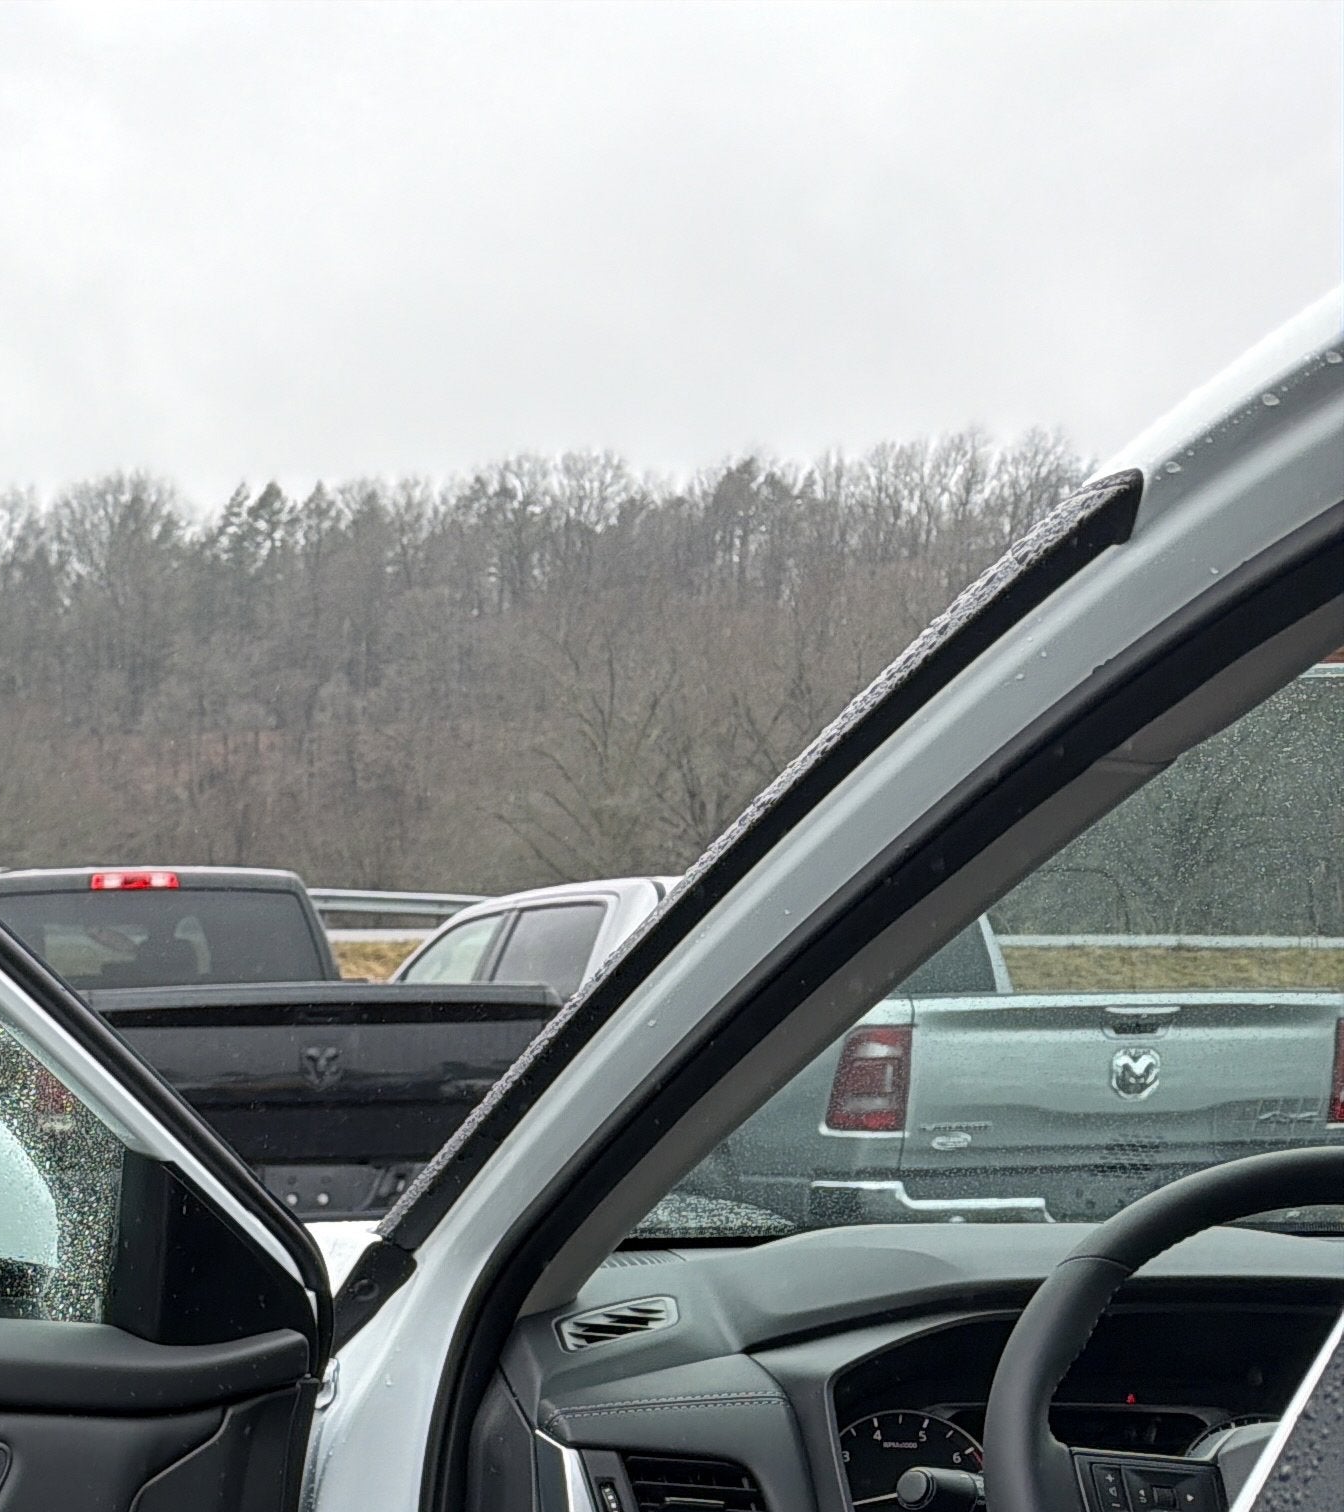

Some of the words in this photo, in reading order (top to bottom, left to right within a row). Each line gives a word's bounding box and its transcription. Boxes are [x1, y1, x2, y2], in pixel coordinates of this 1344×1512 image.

[873, 1430, 882, 1442] 4
[919, 1431, 927, 1442] 5
[842, 1451, 850, 1462] 3
[953, 1453, 961, 1463] 6
